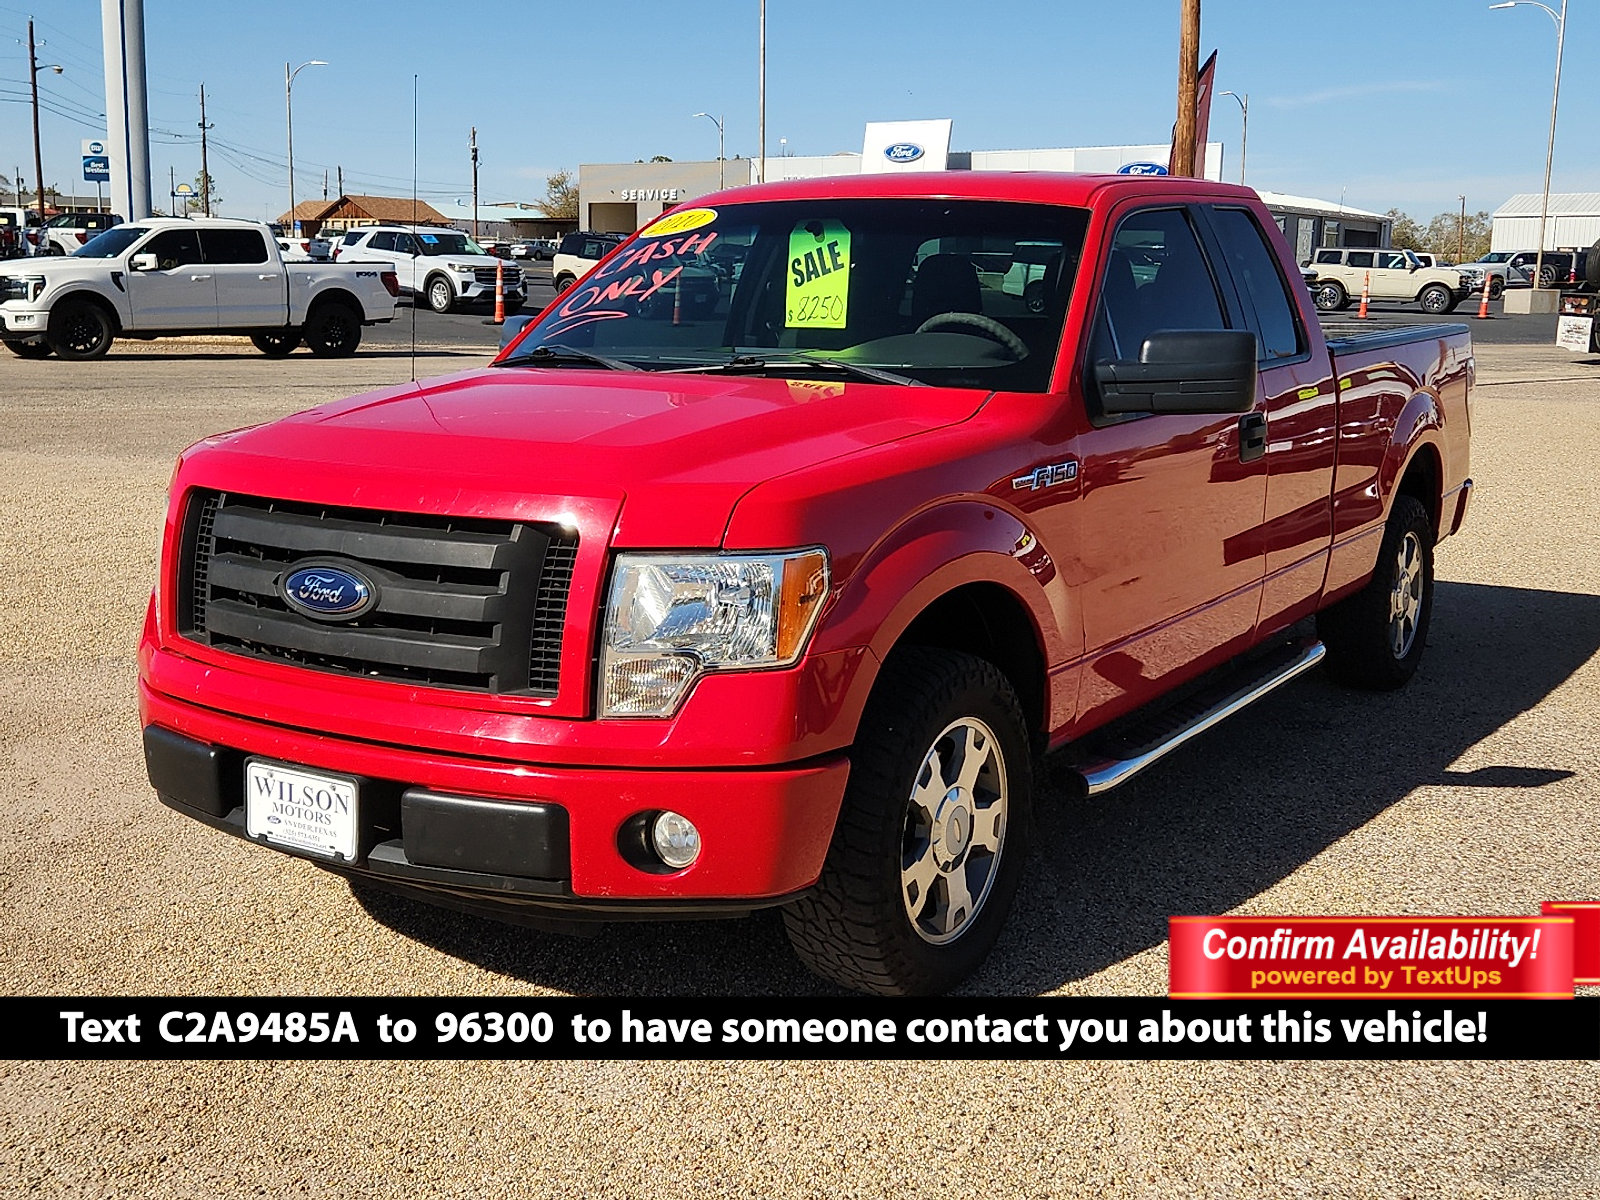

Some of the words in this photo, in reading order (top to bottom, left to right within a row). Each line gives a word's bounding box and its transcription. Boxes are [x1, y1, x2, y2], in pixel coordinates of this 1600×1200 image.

[890, 145, 915, 157] Ford
[621, 188, 678, 200] SERVICE
[595, 232, 718, 280] CASH
[791, 240, 845, 288] SALE
[559, 265, 684, 317] ONLY
[298, 574, 345, 604] Ford
[254, 776, 349, 815] WILSON
[272, 801, 332, 825] MOTORS
